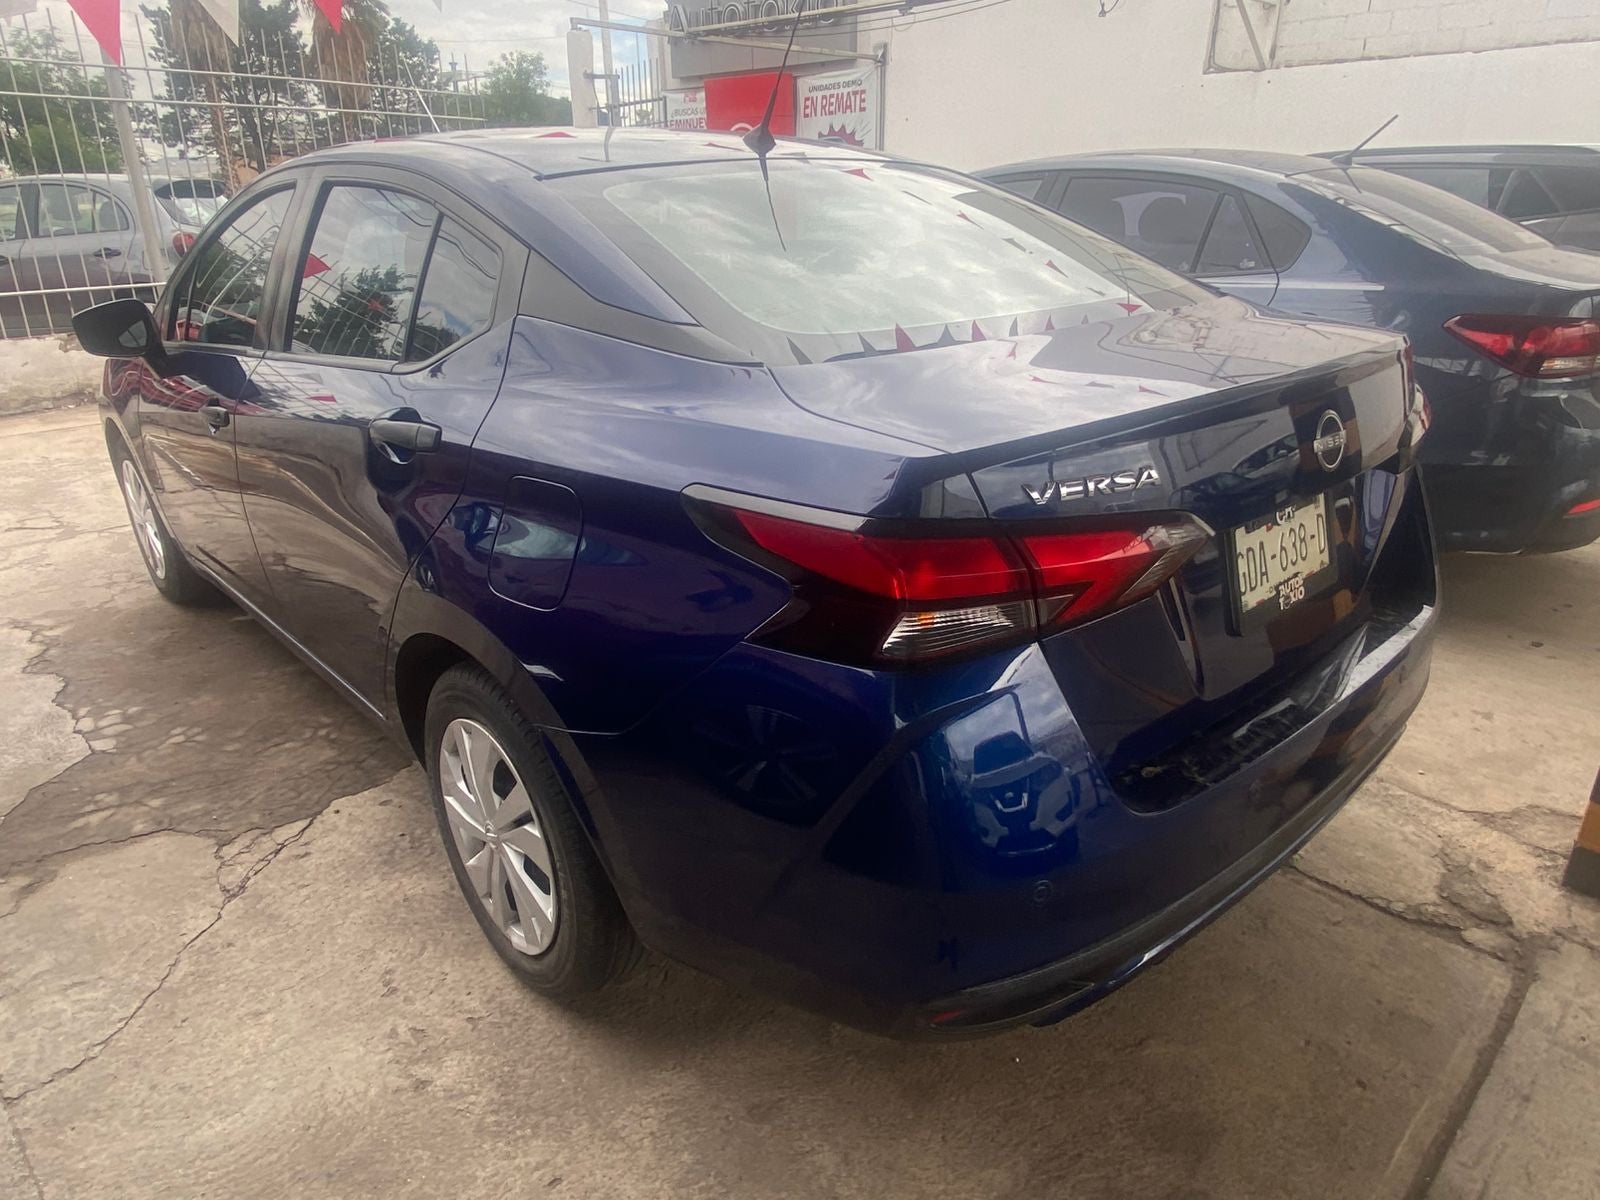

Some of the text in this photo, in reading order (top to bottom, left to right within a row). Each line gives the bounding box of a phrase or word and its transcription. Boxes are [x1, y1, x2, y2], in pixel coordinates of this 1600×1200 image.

[808, 79, 863, 93] UNIDADES DEMO
[803, 89, 867, 119] EN REMATE
[1021, 467, 1160, 505] VERSA
[1236, 513, 1326, 595] GDA-638-D
